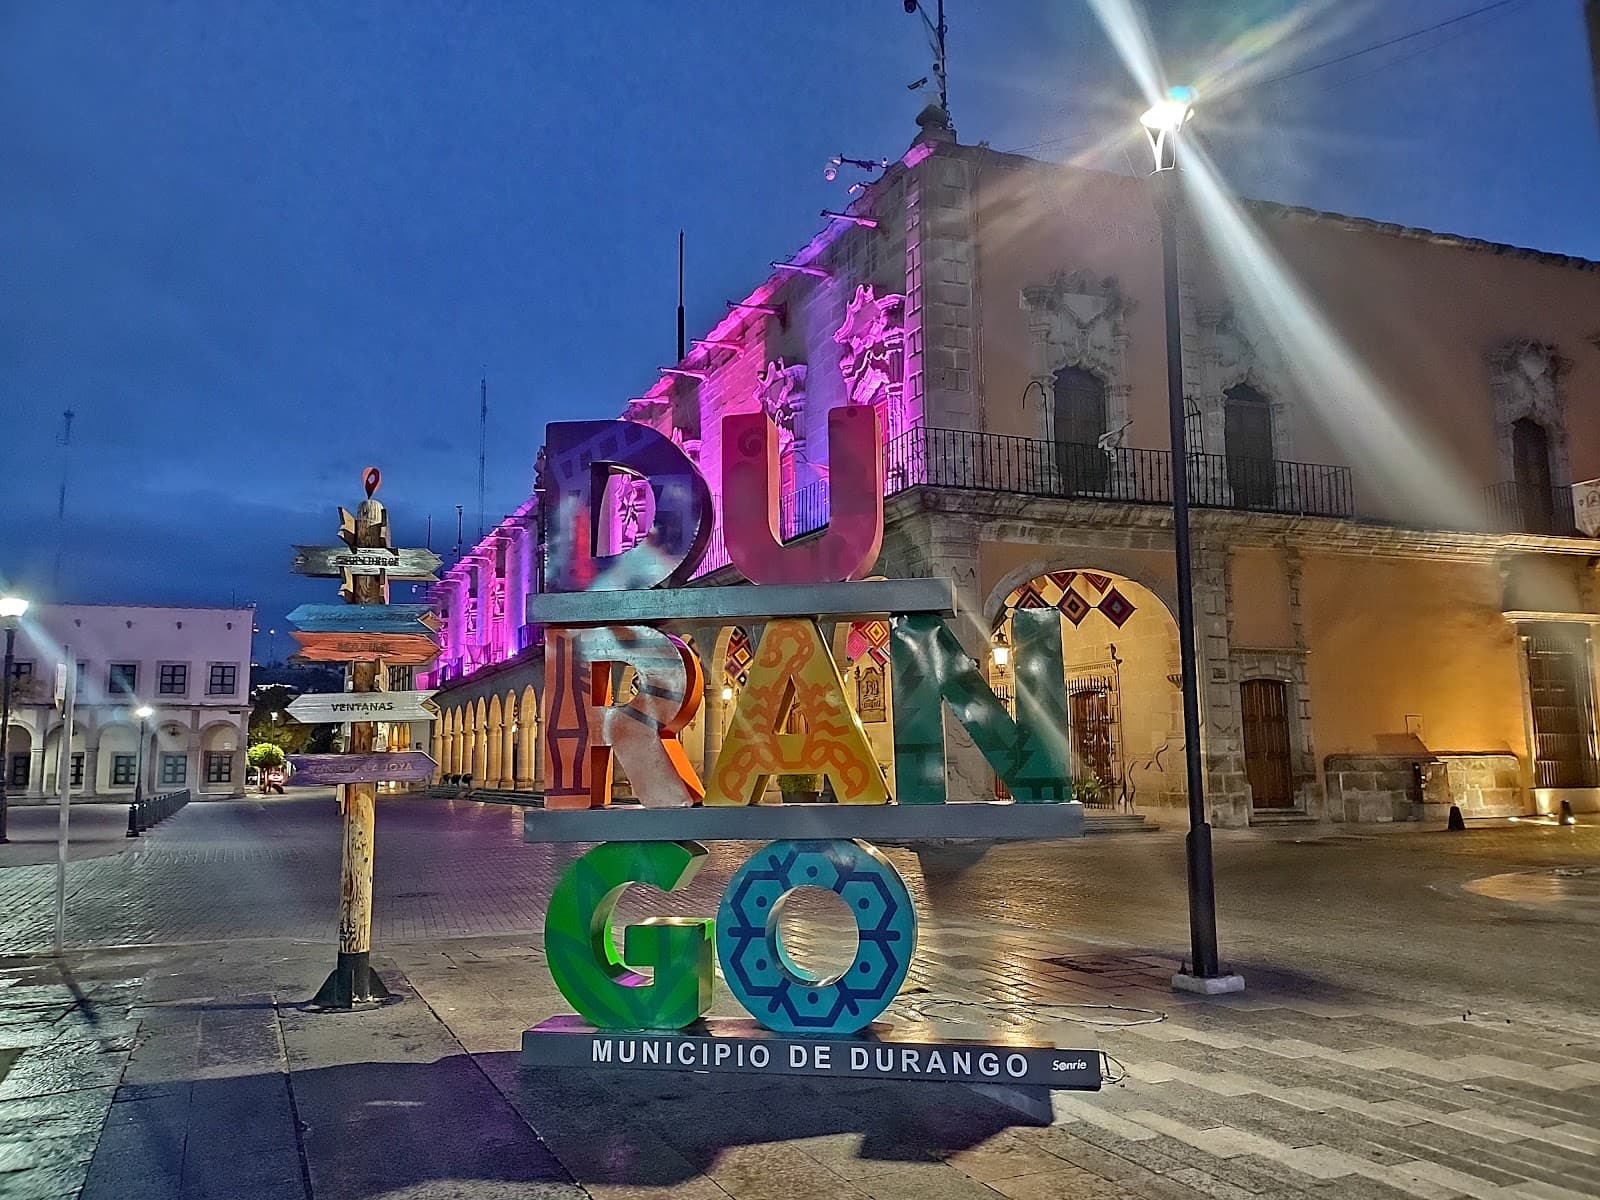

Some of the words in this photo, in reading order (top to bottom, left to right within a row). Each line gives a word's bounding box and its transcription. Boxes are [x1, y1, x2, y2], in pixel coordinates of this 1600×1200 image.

[545, 405, 884, 590] DU
[331, 702, 394, 712] VENTANAS
[544, 607, 1072, 809] RAN
[545, 838, 918, 1033] GO
[592, 1039, 770, 1068] MUNICIPIO
[789, 1045, 832, 1069] DE
[850, 1047, 1029, 1077] DURANGO
